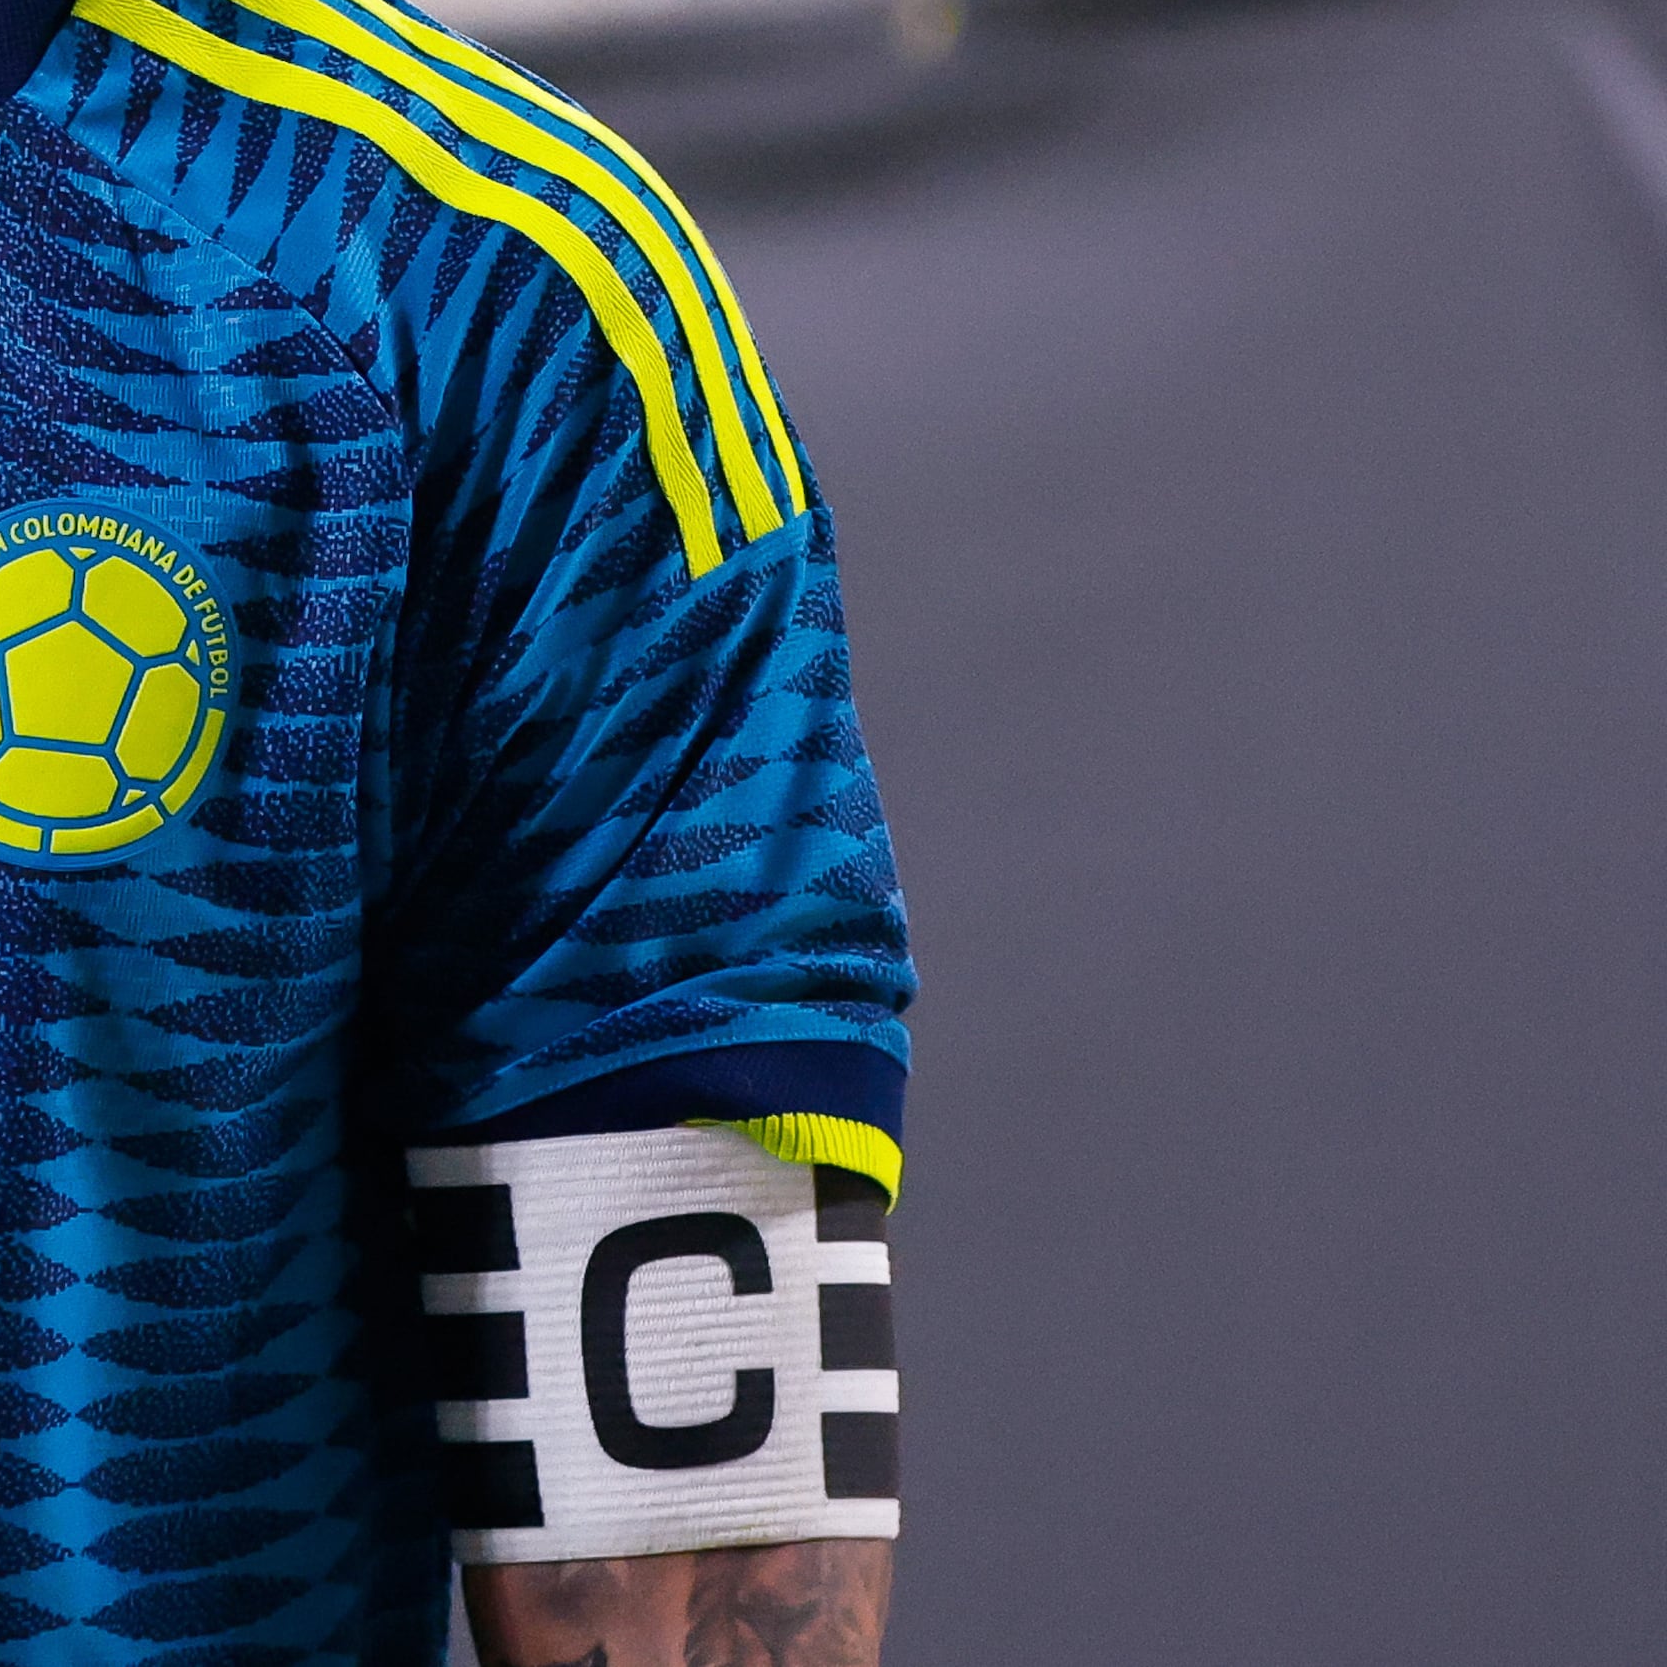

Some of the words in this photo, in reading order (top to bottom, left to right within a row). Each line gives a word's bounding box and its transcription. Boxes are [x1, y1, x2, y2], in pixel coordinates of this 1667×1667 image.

[11, 513, 180, 575] COLOMBIANA
[173, 565, 207, 598] DE
[193, 598, 231, 699] FÚTBOL
[581, 1211, 774, 1470] C
